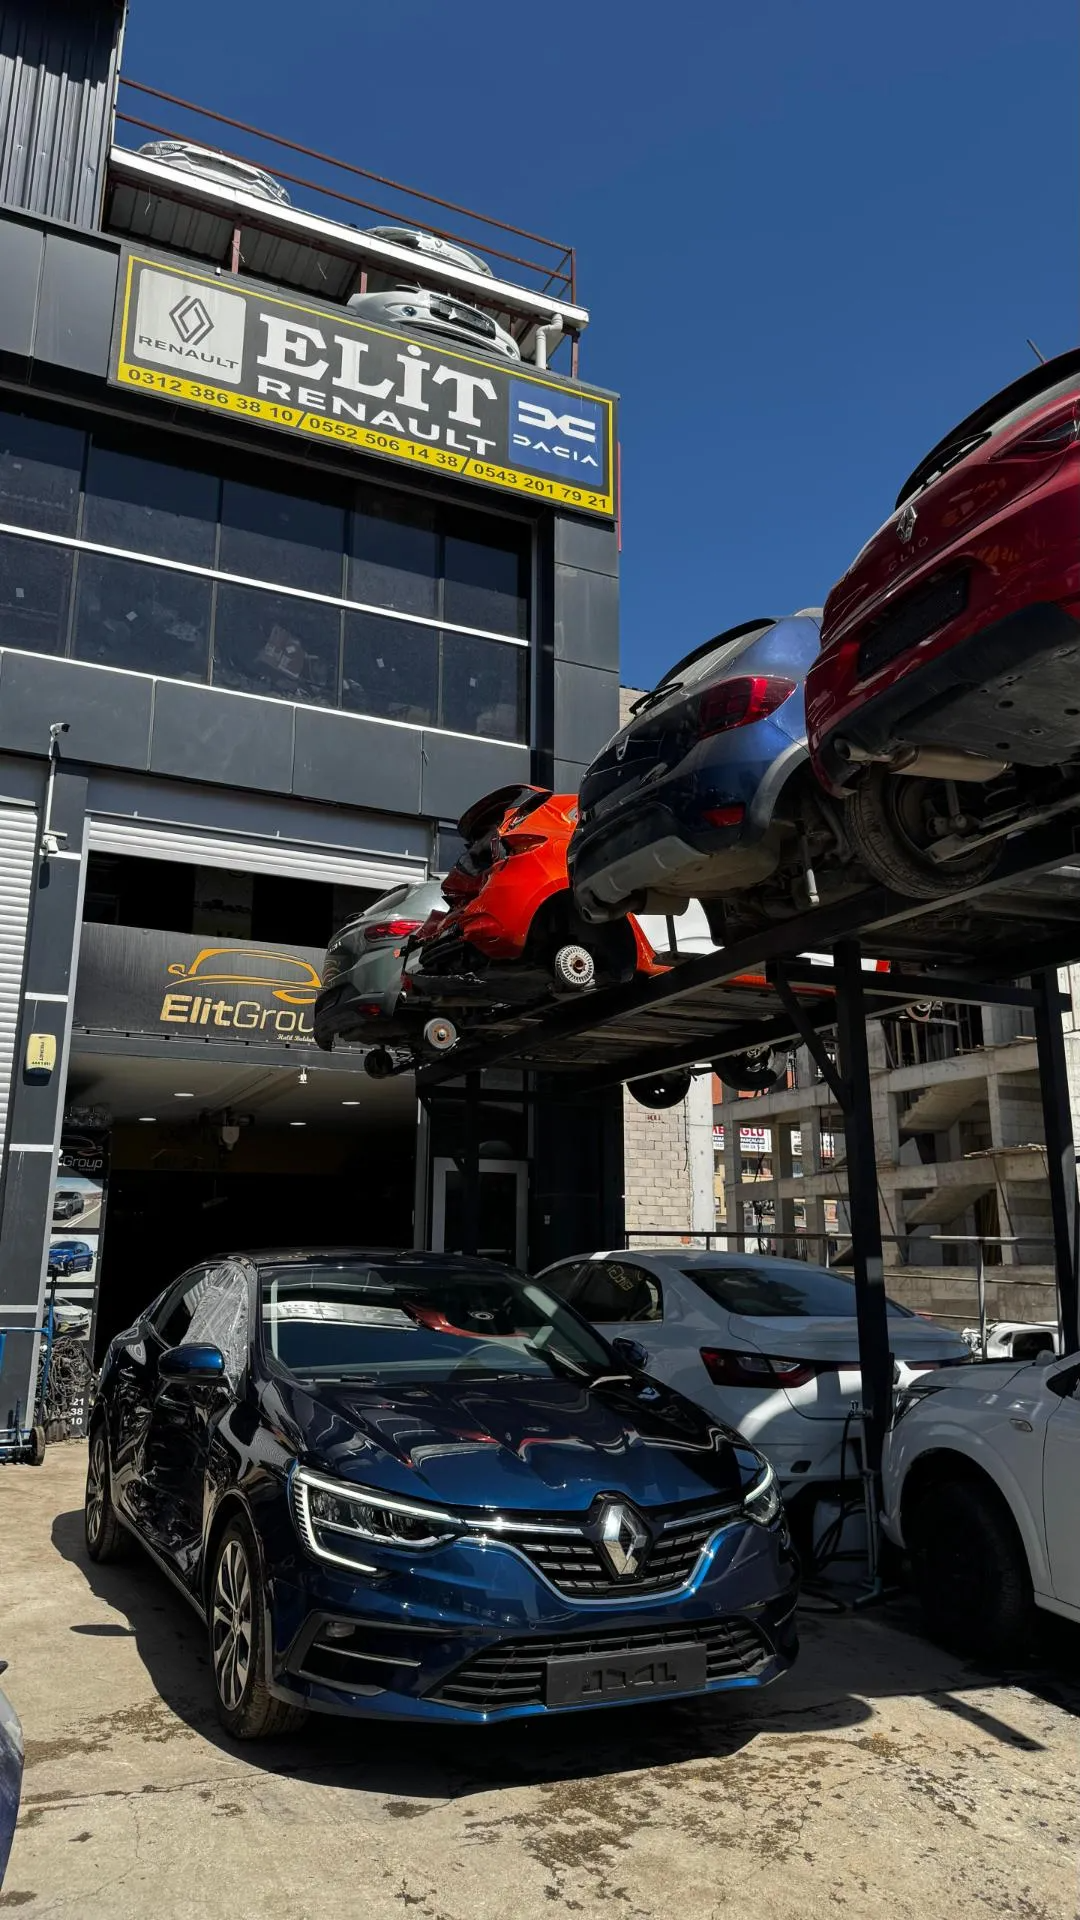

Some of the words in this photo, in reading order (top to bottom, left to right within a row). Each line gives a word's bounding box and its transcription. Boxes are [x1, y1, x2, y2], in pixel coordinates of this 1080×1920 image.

[138, 335, 239, 369] RENAULT
[257, 374, 497, 456] RENAULT
[128, 369, 183, 393] 0312
[189, 385, 229, 405] 386
[236, 398, 261, 413] 38
[365, 432, 401, 452] 506
[408, 444, 430, 460] 14
[524, 476, 554, 495] 201
[561, 487, 582, 502] 79
[587, 495, 608, 509] 21
[511, 433, 599, 467] DACIA
[888, 536, 929, 572] CLIO
[159, 993, 314, 1033] ElitGrou
[70, 1407, 84, 1416] 38
[73, 1398, 85, 1406] 21
[70, 1417, 83, 1425] 10
